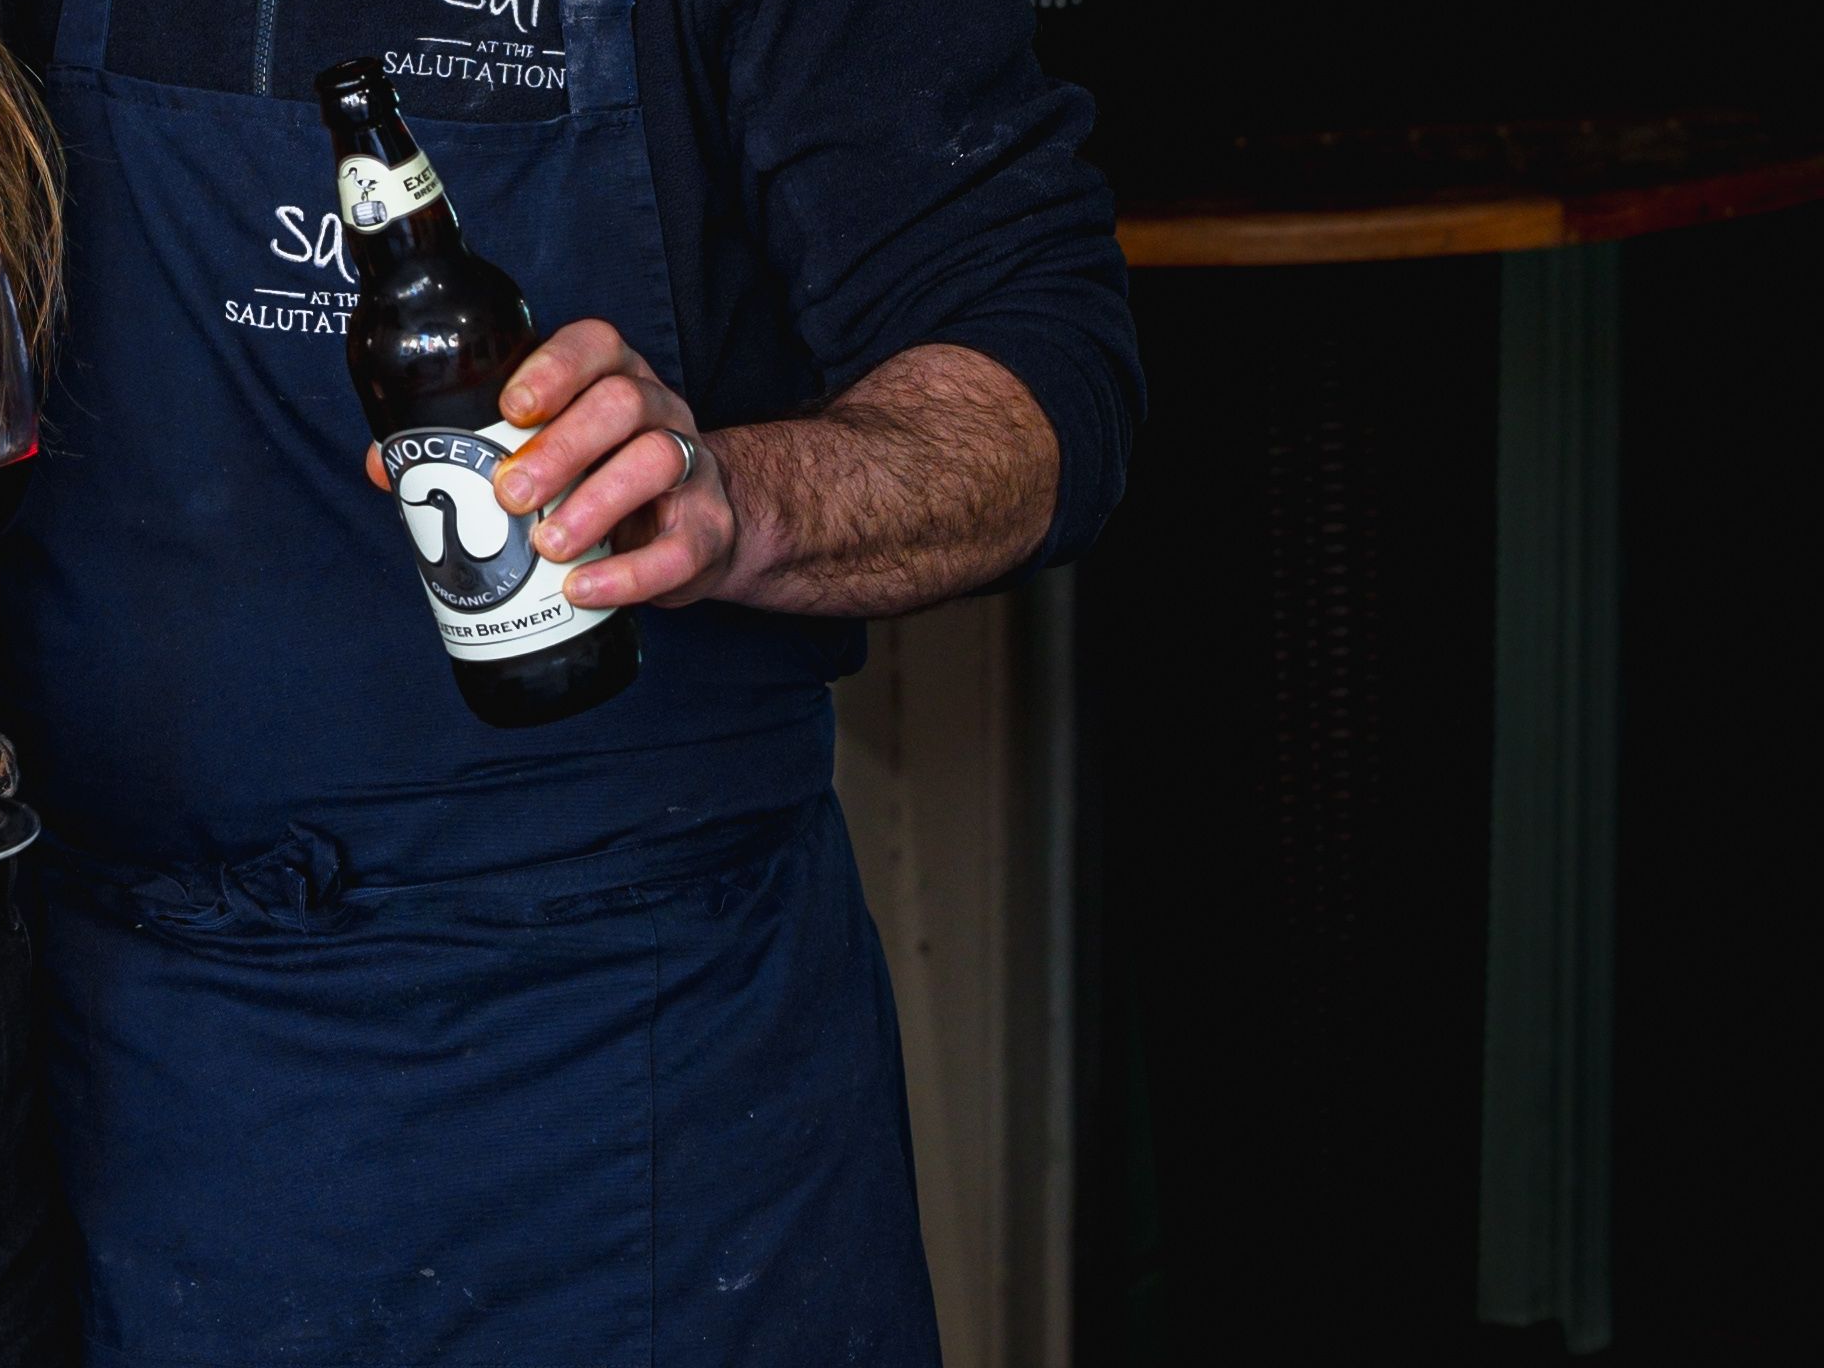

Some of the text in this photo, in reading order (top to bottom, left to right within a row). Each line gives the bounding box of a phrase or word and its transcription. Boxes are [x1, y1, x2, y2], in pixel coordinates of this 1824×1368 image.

[476, 40, 535, 59] AT THE
[383, 51, 567, 91] SALUTATION
[403, 166, 433, 192] EXET
[270, 205, 356, 284] Sa
[225, 299, 352, 334] SALUTAT
[310, 291, 360, 307] AT TH
[385, 437, 495, 479] AVOCET
[432, 568, 522, 607] ORGANIC ALE
[440, 604, 562, 638] ETER BREWERY
